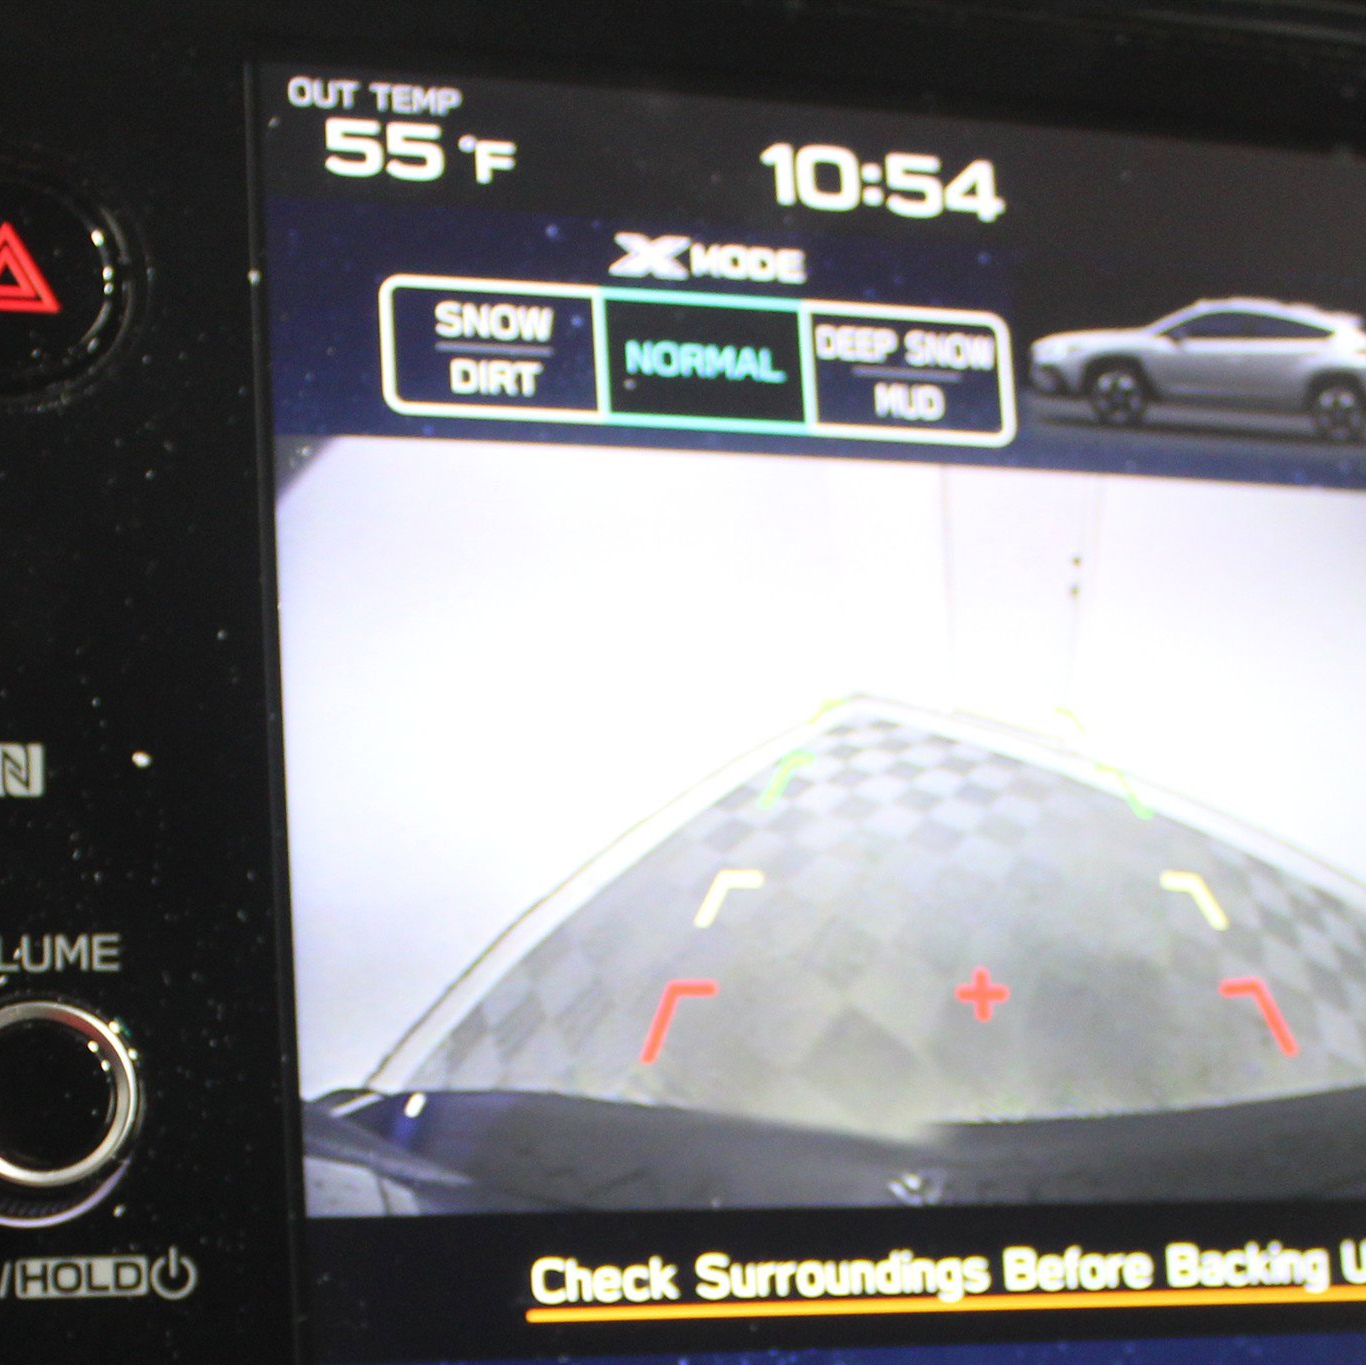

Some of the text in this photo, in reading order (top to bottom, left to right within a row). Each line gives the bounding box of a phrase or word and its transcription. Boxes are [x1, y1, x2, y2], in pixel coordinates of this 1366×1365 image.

[287, 76, 463, 117] OUT TEMP
[323, 117, 446, 183] 55
[760, 141, 1005, 224] 10:54
[435, 301, 554, 345] SNOW
[624, 338, 787, 385] NORMAL
[814, 323, 996, 372] DEEP SNOW
[449, 357, 544, 399] DIRT
[872, 381, 945, 422] MUD
[530, 1255, 679, 1305] Check
[694, 1250, 989, 1302] Surroundings
[1003, 1245, 1153, 1293] Before
[1165, 1240, 1332, 1294] Backing
